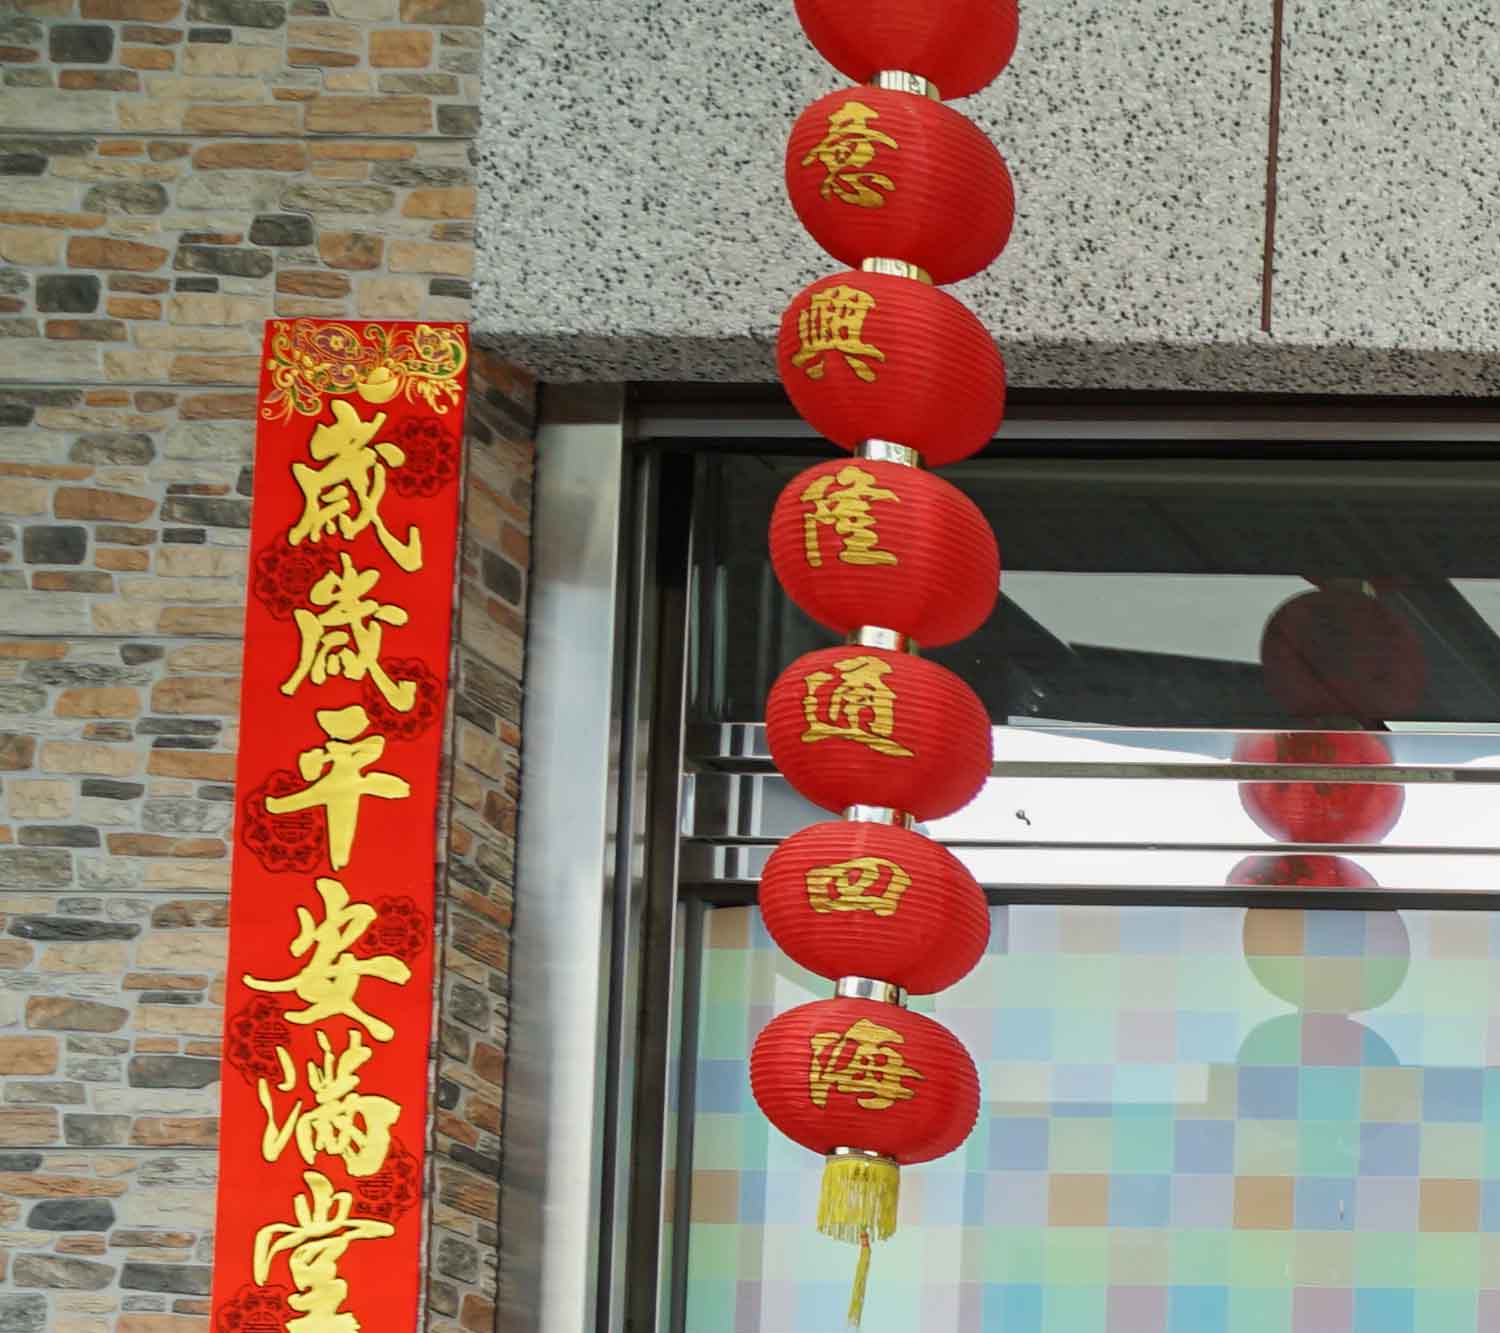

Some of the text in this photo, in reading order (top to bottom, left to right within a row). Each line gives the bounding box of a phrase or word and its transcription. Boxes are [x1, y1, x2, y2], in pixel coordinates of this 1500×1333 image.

[792, 101, 926, 1111] 意興隆通四海
